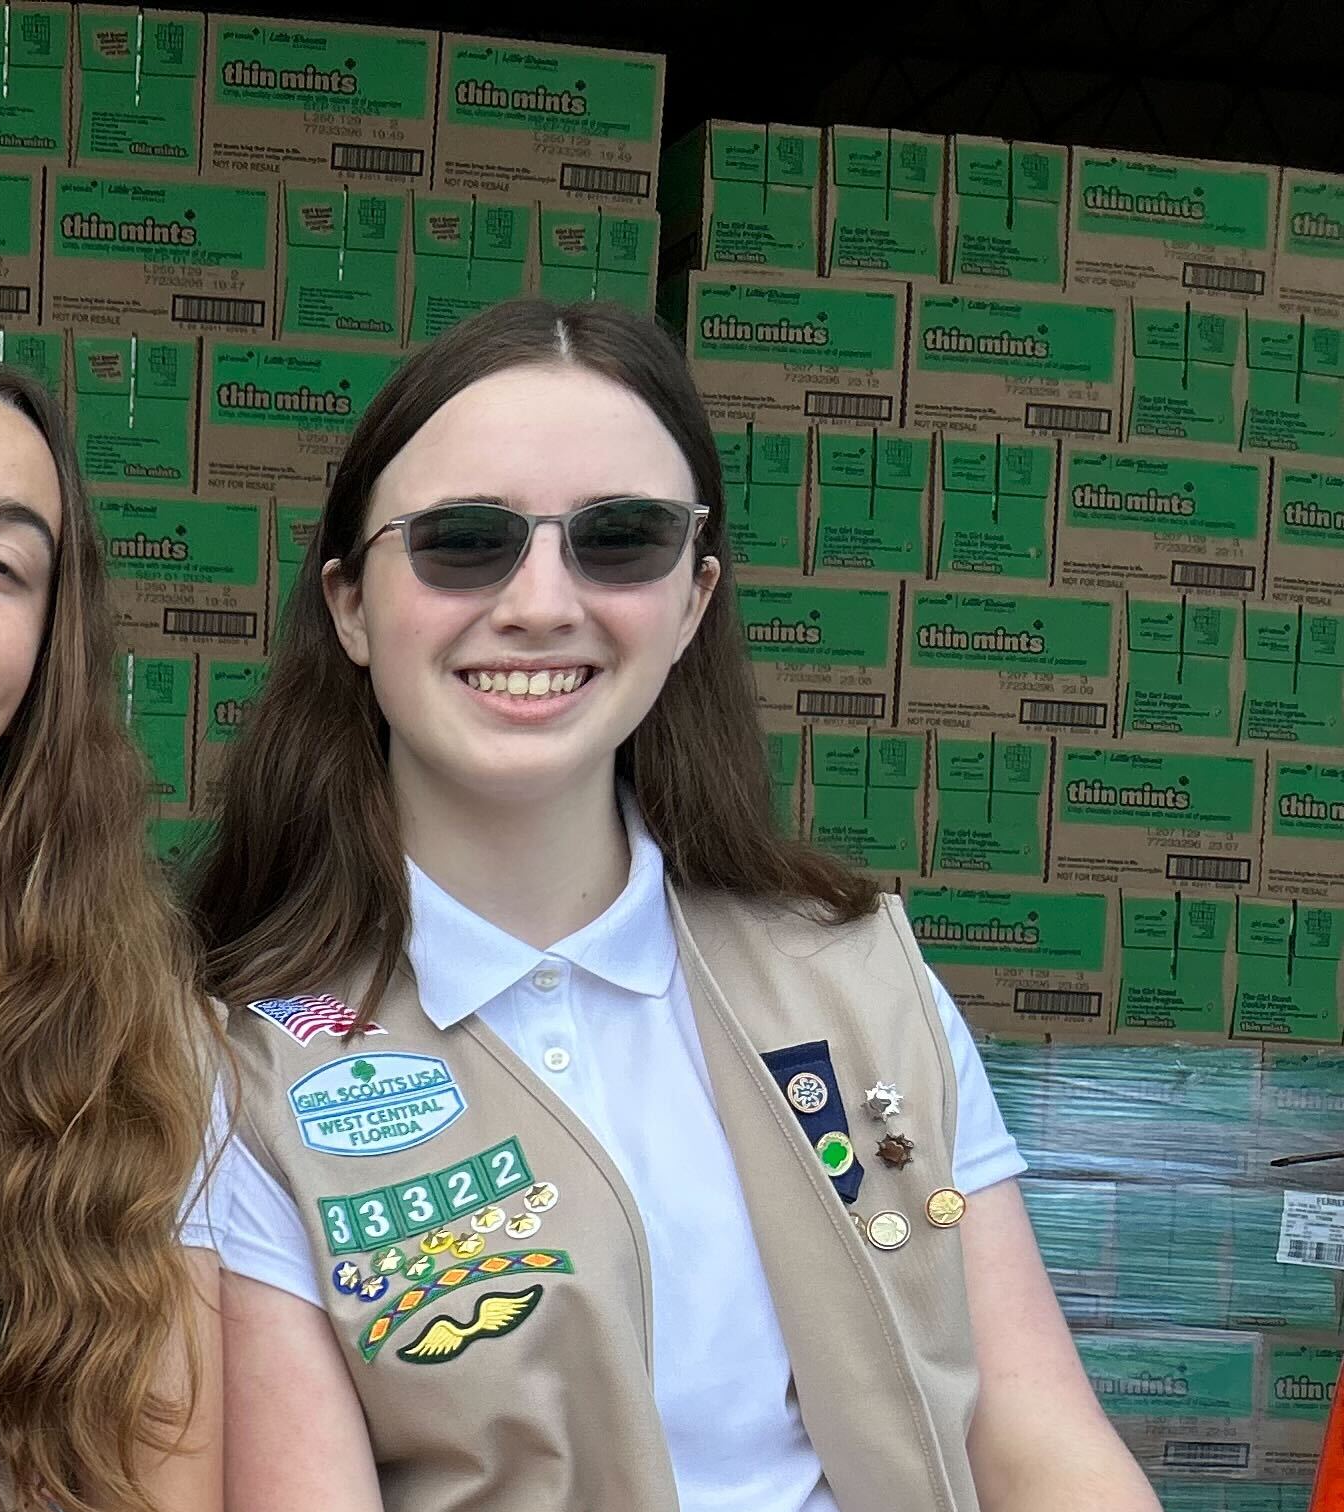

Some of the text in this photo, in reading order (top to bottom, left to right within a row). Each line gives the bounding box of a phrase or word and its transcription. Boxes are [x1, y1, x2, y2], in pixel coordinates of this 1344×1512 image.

[223, 60, 357, 95] thin mints
[456, 79, 587, 116] thin mints
[61, 213, 197, 247] thin mints
[701, 314, 829, 344] thin mints
[923, 326, 1048, 358] thin mints
[218, 382, 351, 414] thin mints
[124, 463, 181, 478] thin mints
[1073, 484, 1195, 516] thin mints
[1285, 502, 1331, 529] thin
[112, 533, 188, 560] mints
[747, 617, 821, 644] mints
[917, 624, 1045, 655] thin mints
[1066, 780, 1190, 809] thin mints
[1279, 793, 1327, 820] thin
[912, 915, 1040, 944] thin mints
[297, 1068, 446, 1110] GIRL SCOUTS USA
[317, 1099, 443, 1136] WEST CENTRAL
[350, 1120, 423, 1146] FLORIDA
[328, 1150, 521, 1244] 33322
[1274, 1375, 1323, 1400] thin
